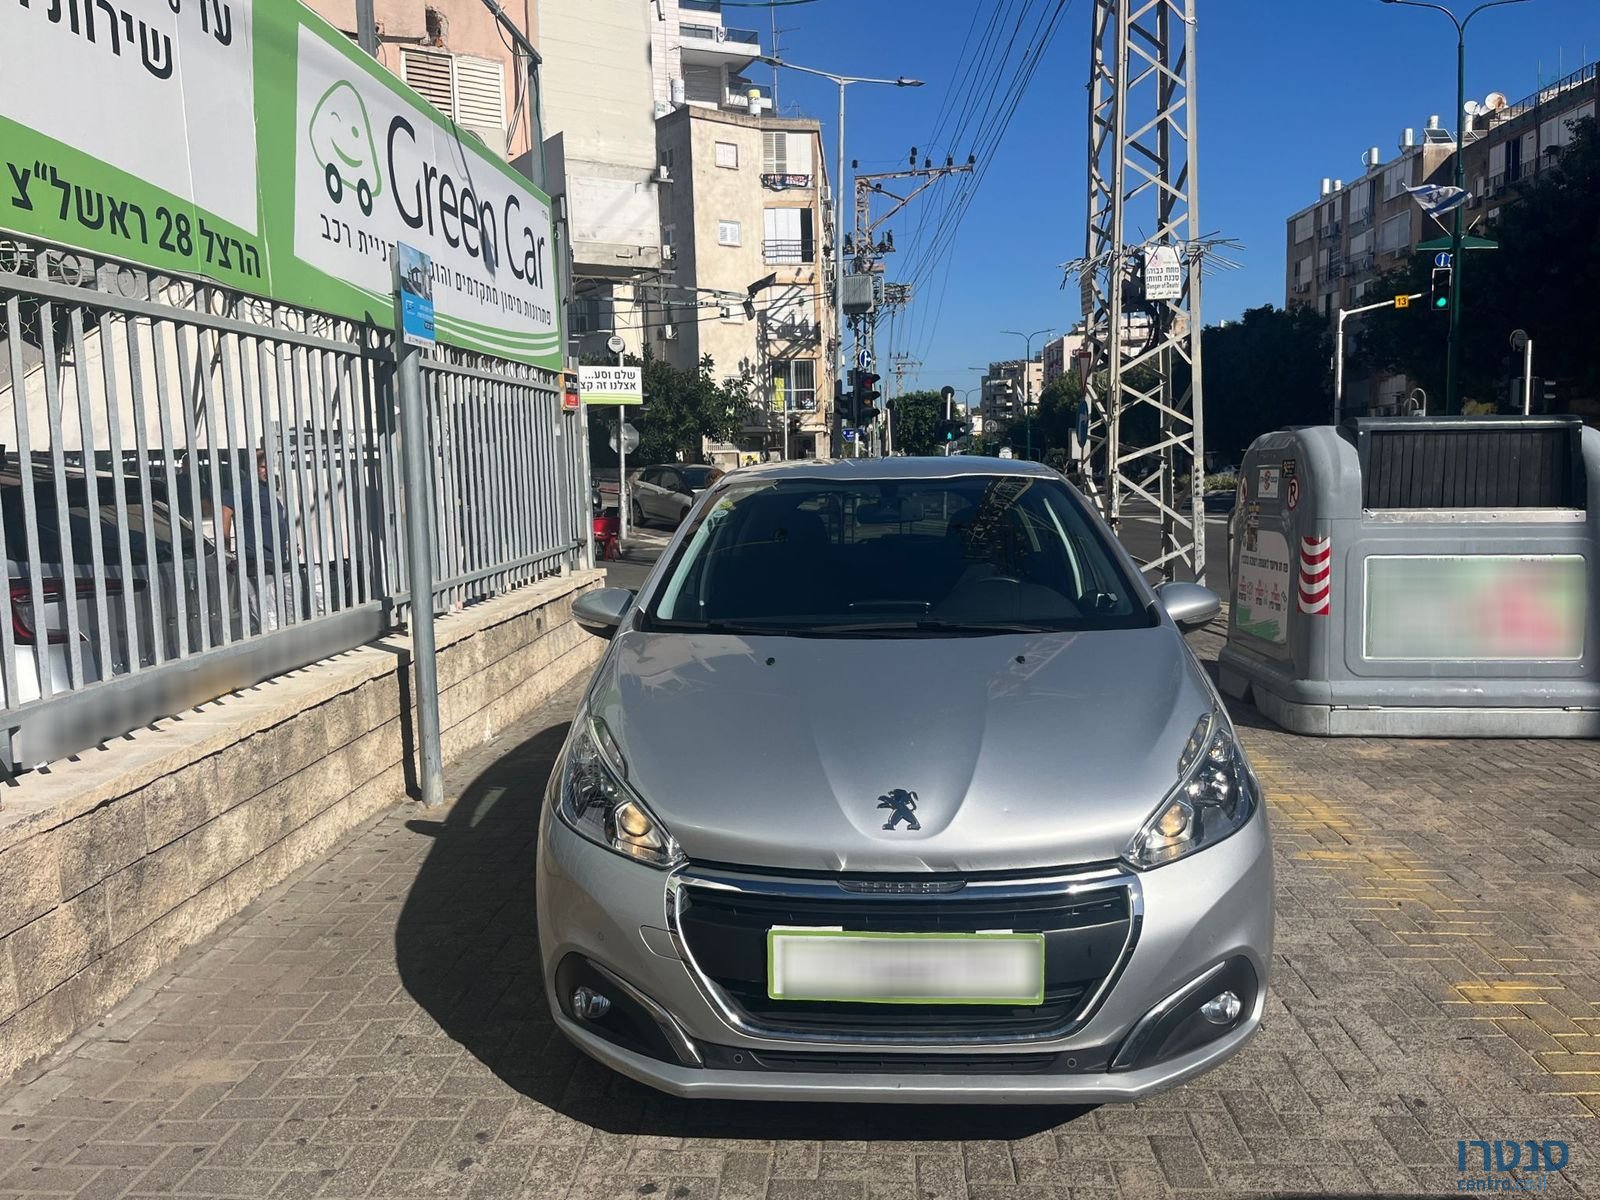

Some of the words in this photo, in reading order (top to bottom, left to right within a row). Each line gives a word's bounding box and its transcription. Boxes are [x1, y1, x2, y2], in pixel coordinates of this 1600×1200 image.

[6, 160, 148, 244] ראשל"צ
[387, 115, 499, 268] Green
[504, 194, 545, 290] Car
[155, 206, 193, 256] 28
[320, 213, 352, 249] רכב
[199, 218, 261, 278] הרצל
[358, 230, 395, 262] ניית
[455, 271, 499, 306] מתקדמים
[500, 290, 522, 315] מימון
[524, 300, 551, 326] פתרונות
[580, 381, 594, 392] קצ
[584, 370, 611, 380] וסע...
[596, 381, 607, 390] זה
[610, 381, 637, 390] אצלנו
[614, 370, 636, 380] שלם
